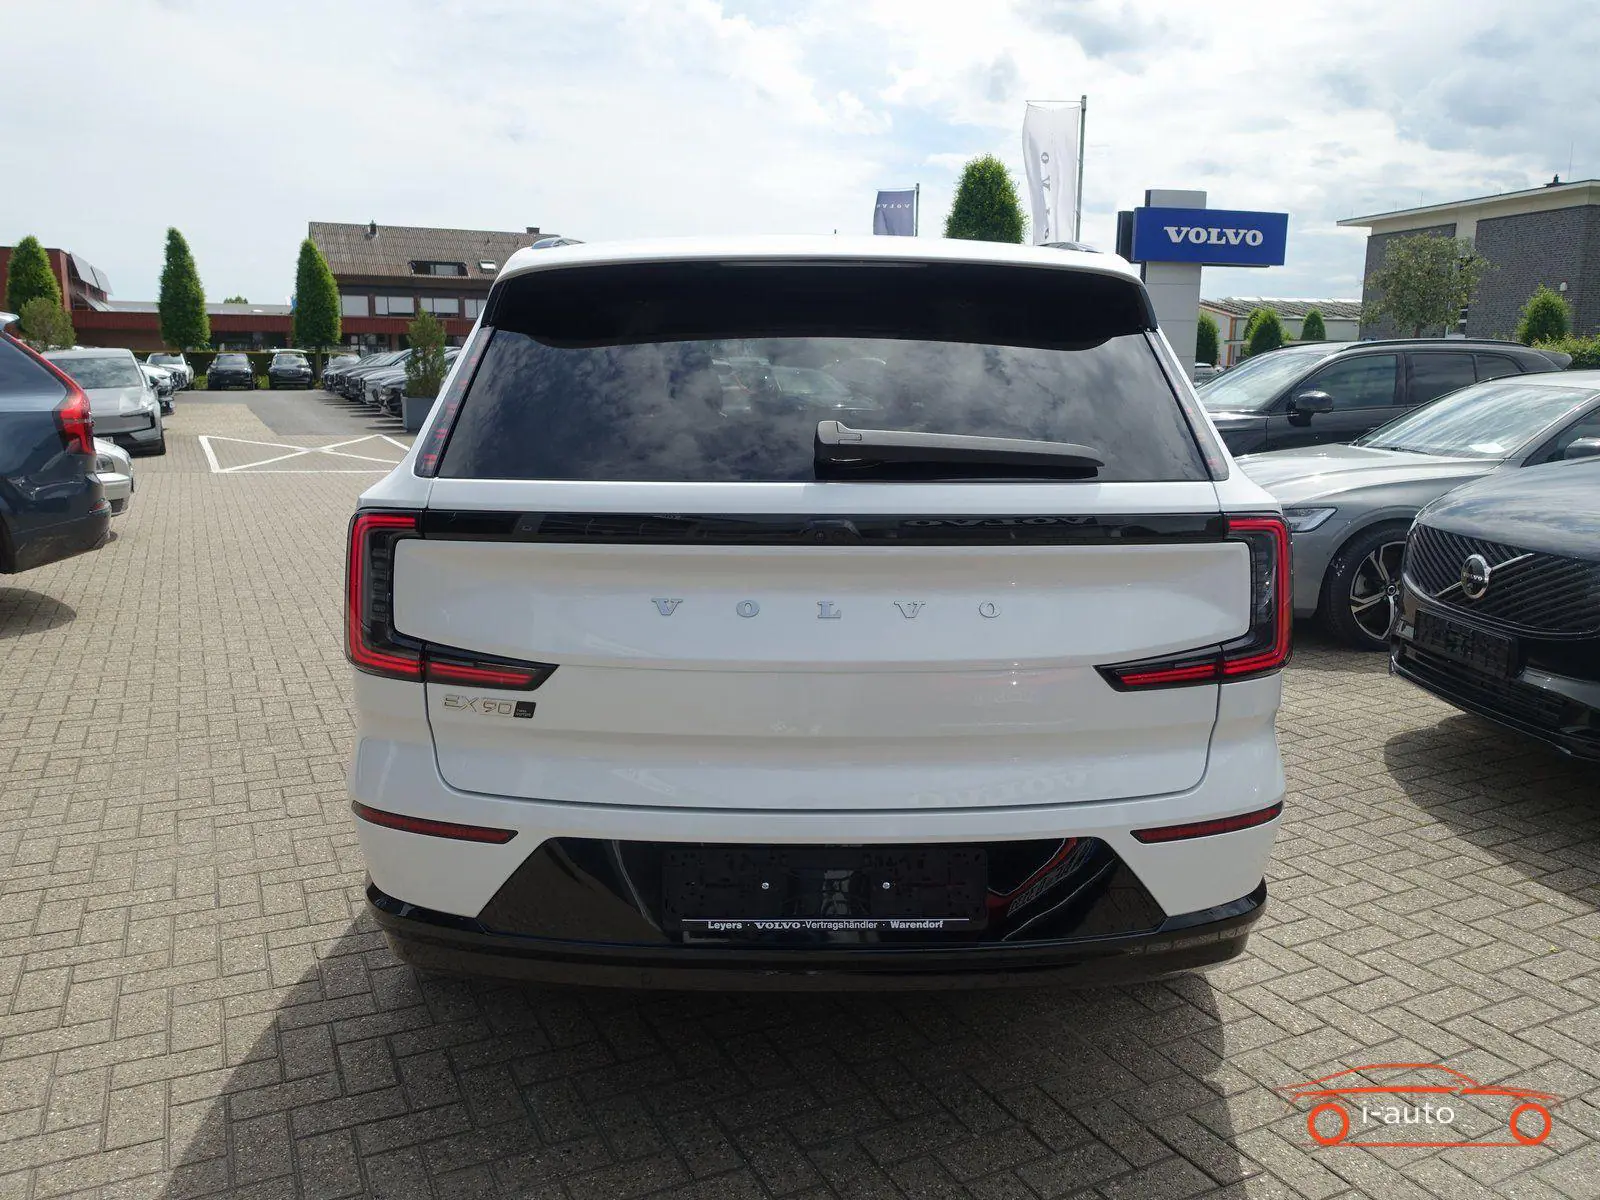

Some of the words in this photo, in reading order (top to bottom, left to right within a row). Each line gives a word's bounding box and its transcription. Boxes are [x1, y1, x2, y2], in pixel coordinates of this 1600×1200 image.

[1163, 226, 1264, 247] VOLVO
[651, 598, 1002, 620] VOLVO
[443, 695, 513, 715] EX90
[707, 920, 743, 931] Leyers
[890, 920, 944, 929] Warendorf
